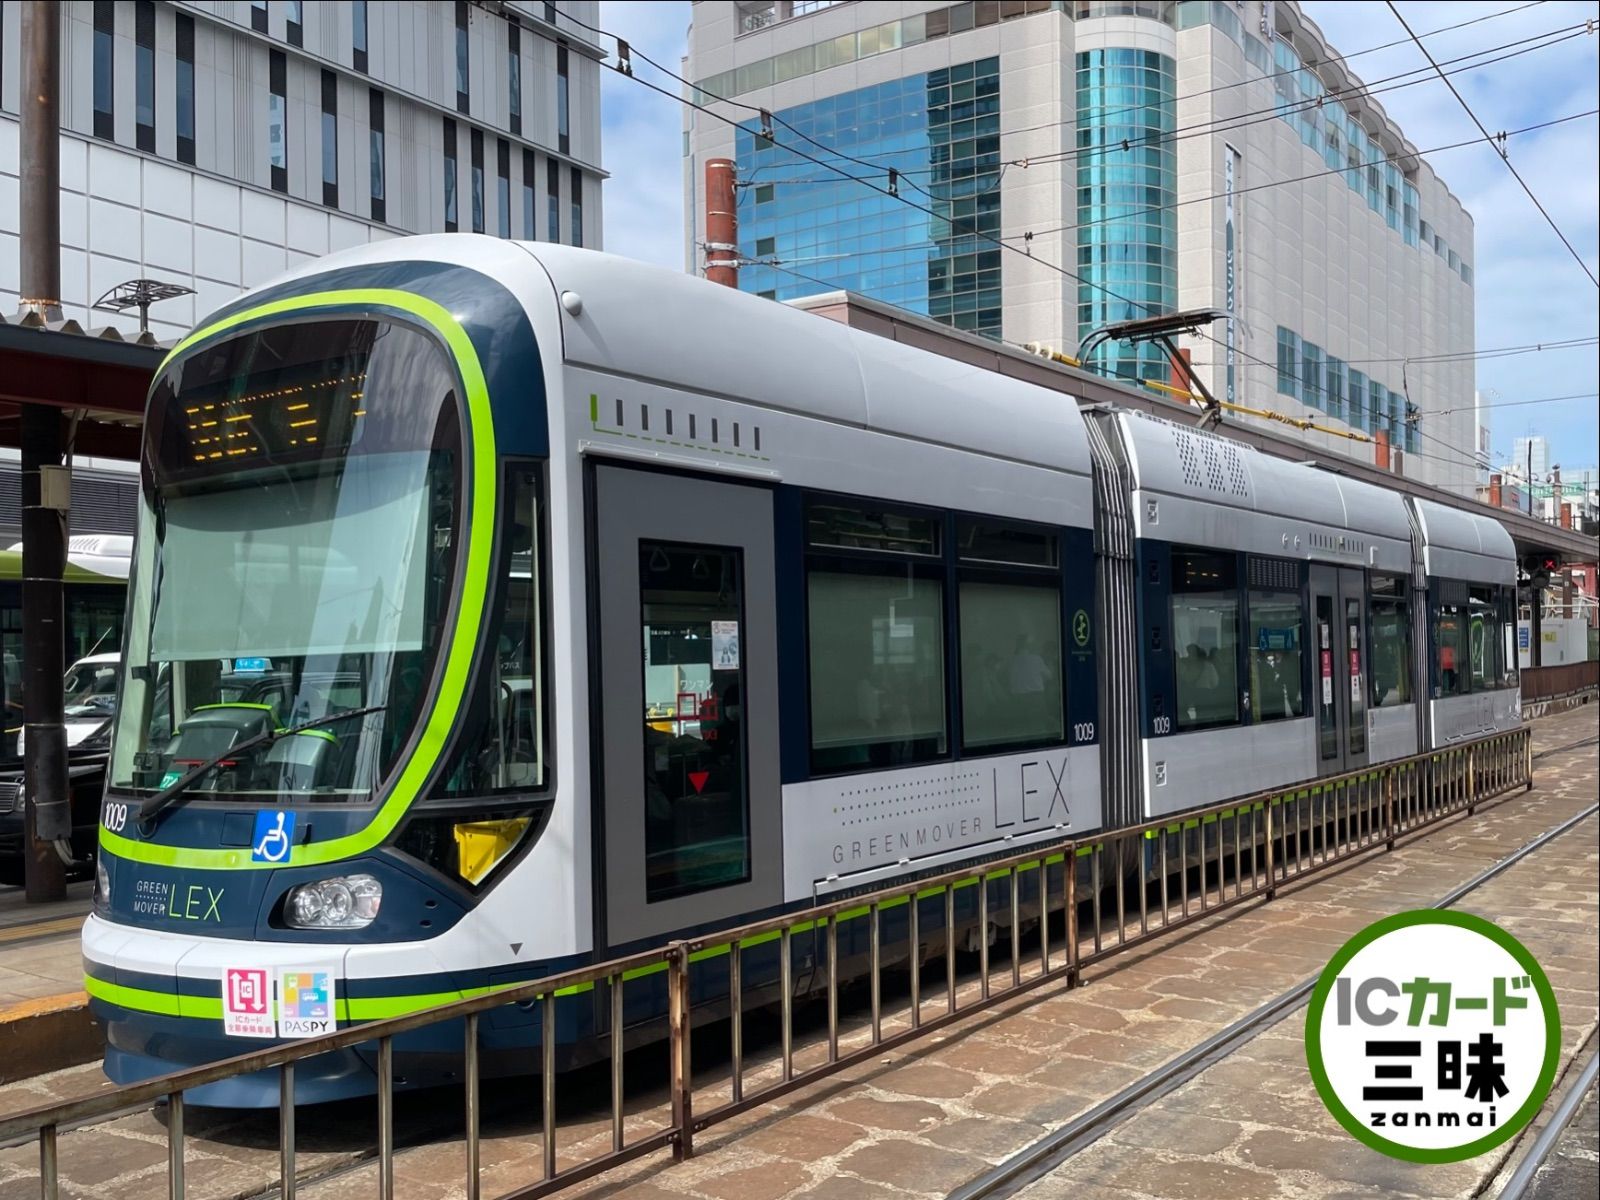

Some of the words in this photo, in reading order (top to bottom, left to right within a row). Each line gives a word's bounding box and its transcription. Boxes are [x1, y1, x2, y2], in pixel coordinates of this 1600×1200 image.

[1073, 722, 1095, 741] 1009
[1153, 717, 1170, 734] 1009
[993, 757, 1070, 829] LEX
[104, 802, 127, 832] 1009
[136, 880, 168, 895] GREEN
[133, 900, 166, 916] MOVER
[168, 883, 225, 923] LEX
[242, 985, 251, 994] IC
[235, 1015, 263, 1024] ICカード
[284, 1021, 329, 1033] PASPY
